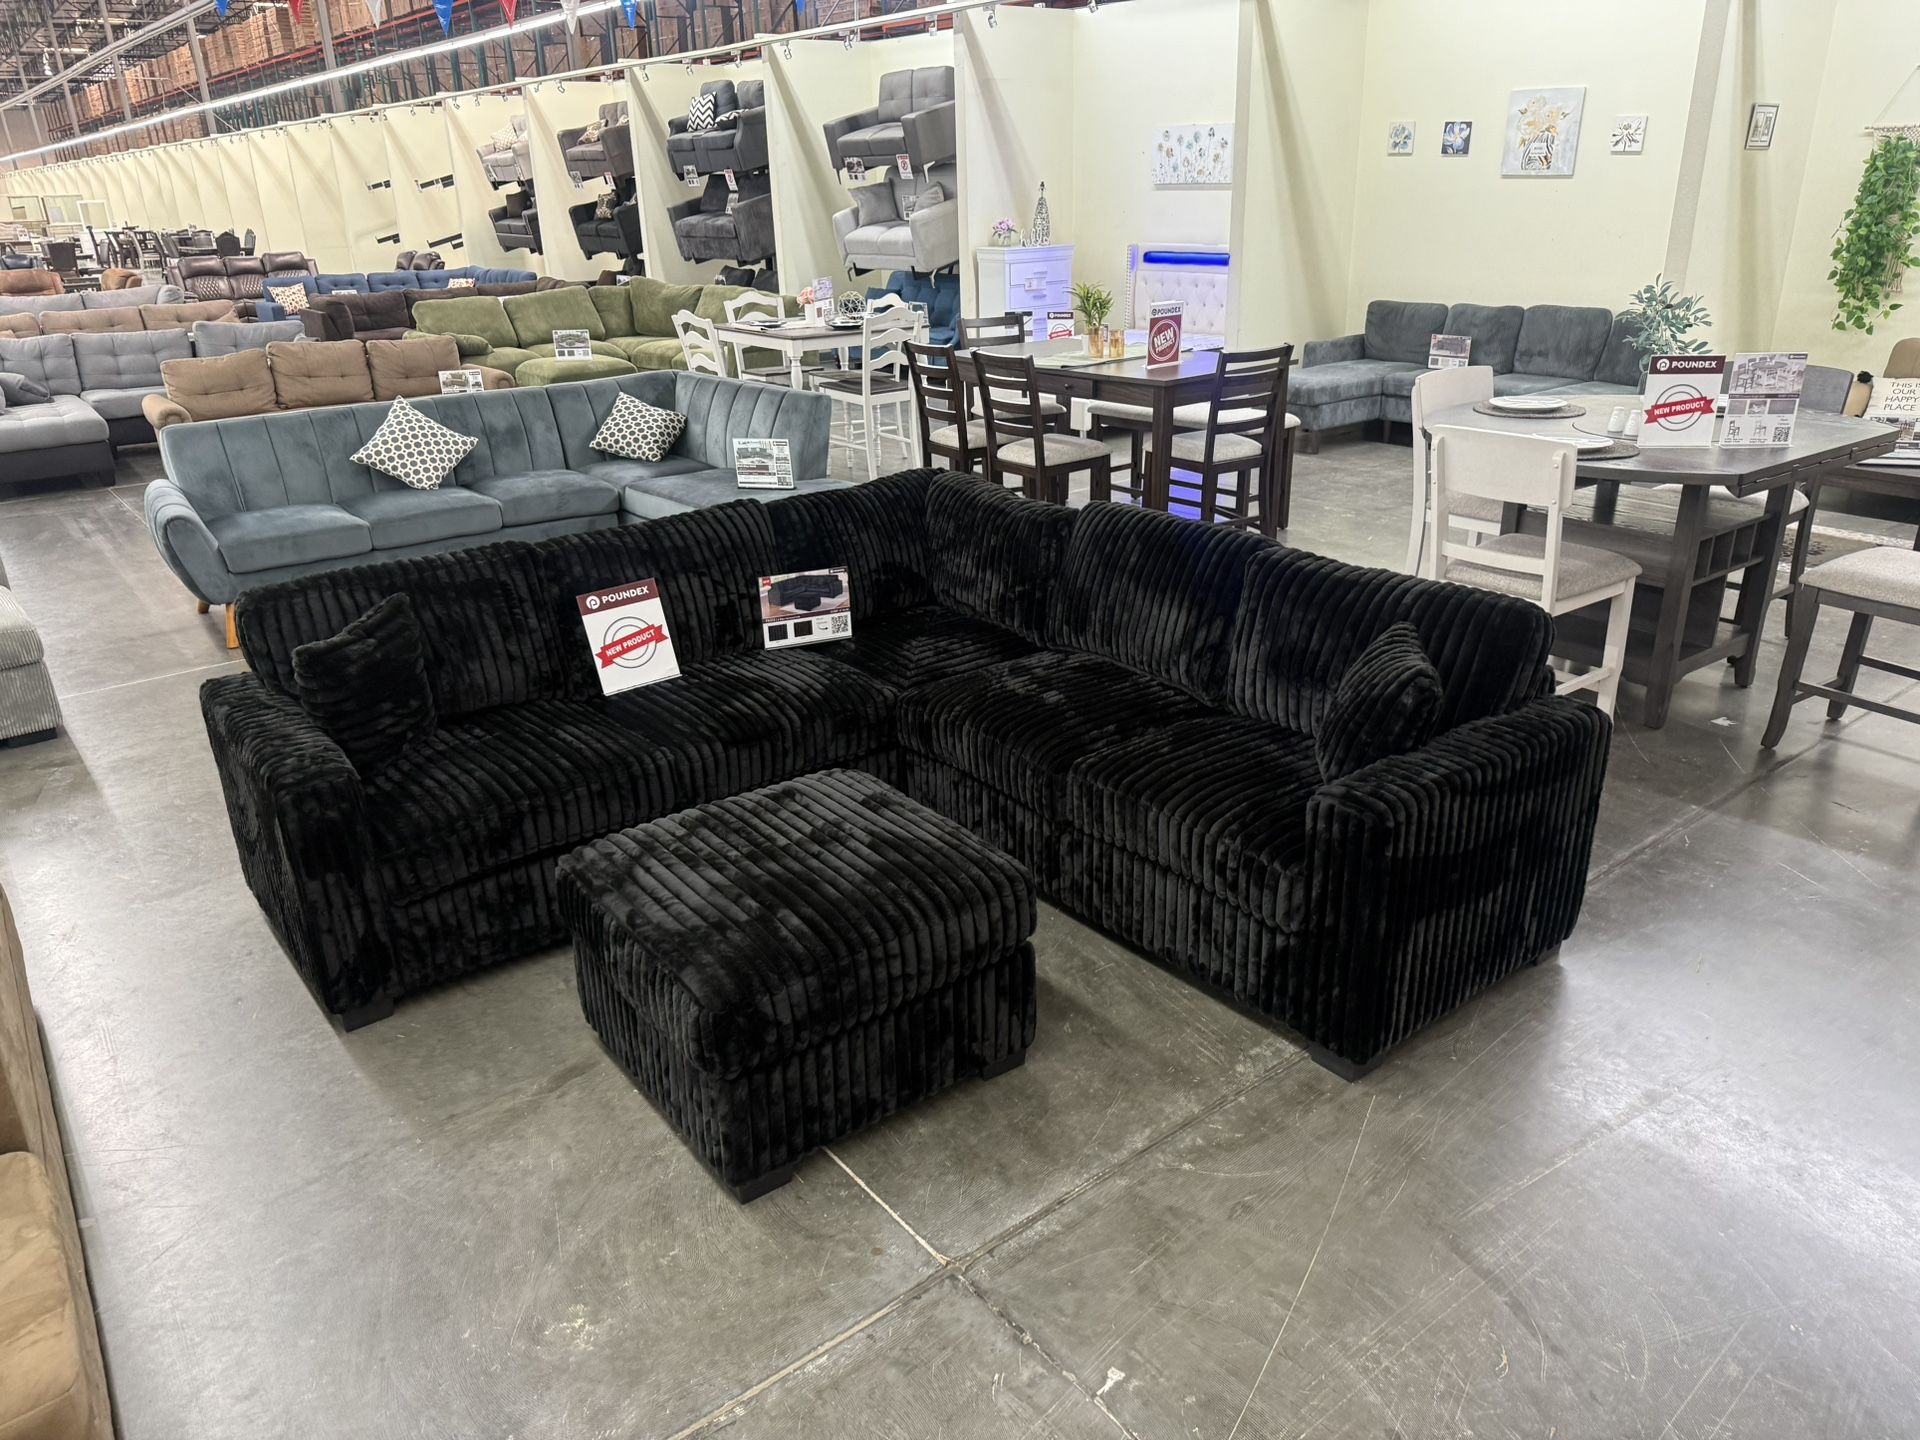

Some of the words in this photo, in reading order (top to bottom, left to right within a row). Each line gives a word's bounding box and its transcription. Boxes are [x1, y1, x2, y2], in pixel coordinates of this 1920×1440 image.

[1157, 306, 1181, 315] POUNDEX
[1153, 327, 1174, 348] NEW
[1671, 361, 1717, 369] POUNDEX
[1654, 406, 1670, 415] NEW
[1671, 401, 1705, 413] PRODUCT
[602, 586, 650, 604] POUNDEX
[605, 643, 623, 657] NEW
[622, 629, 656, 650] PRODUCT
